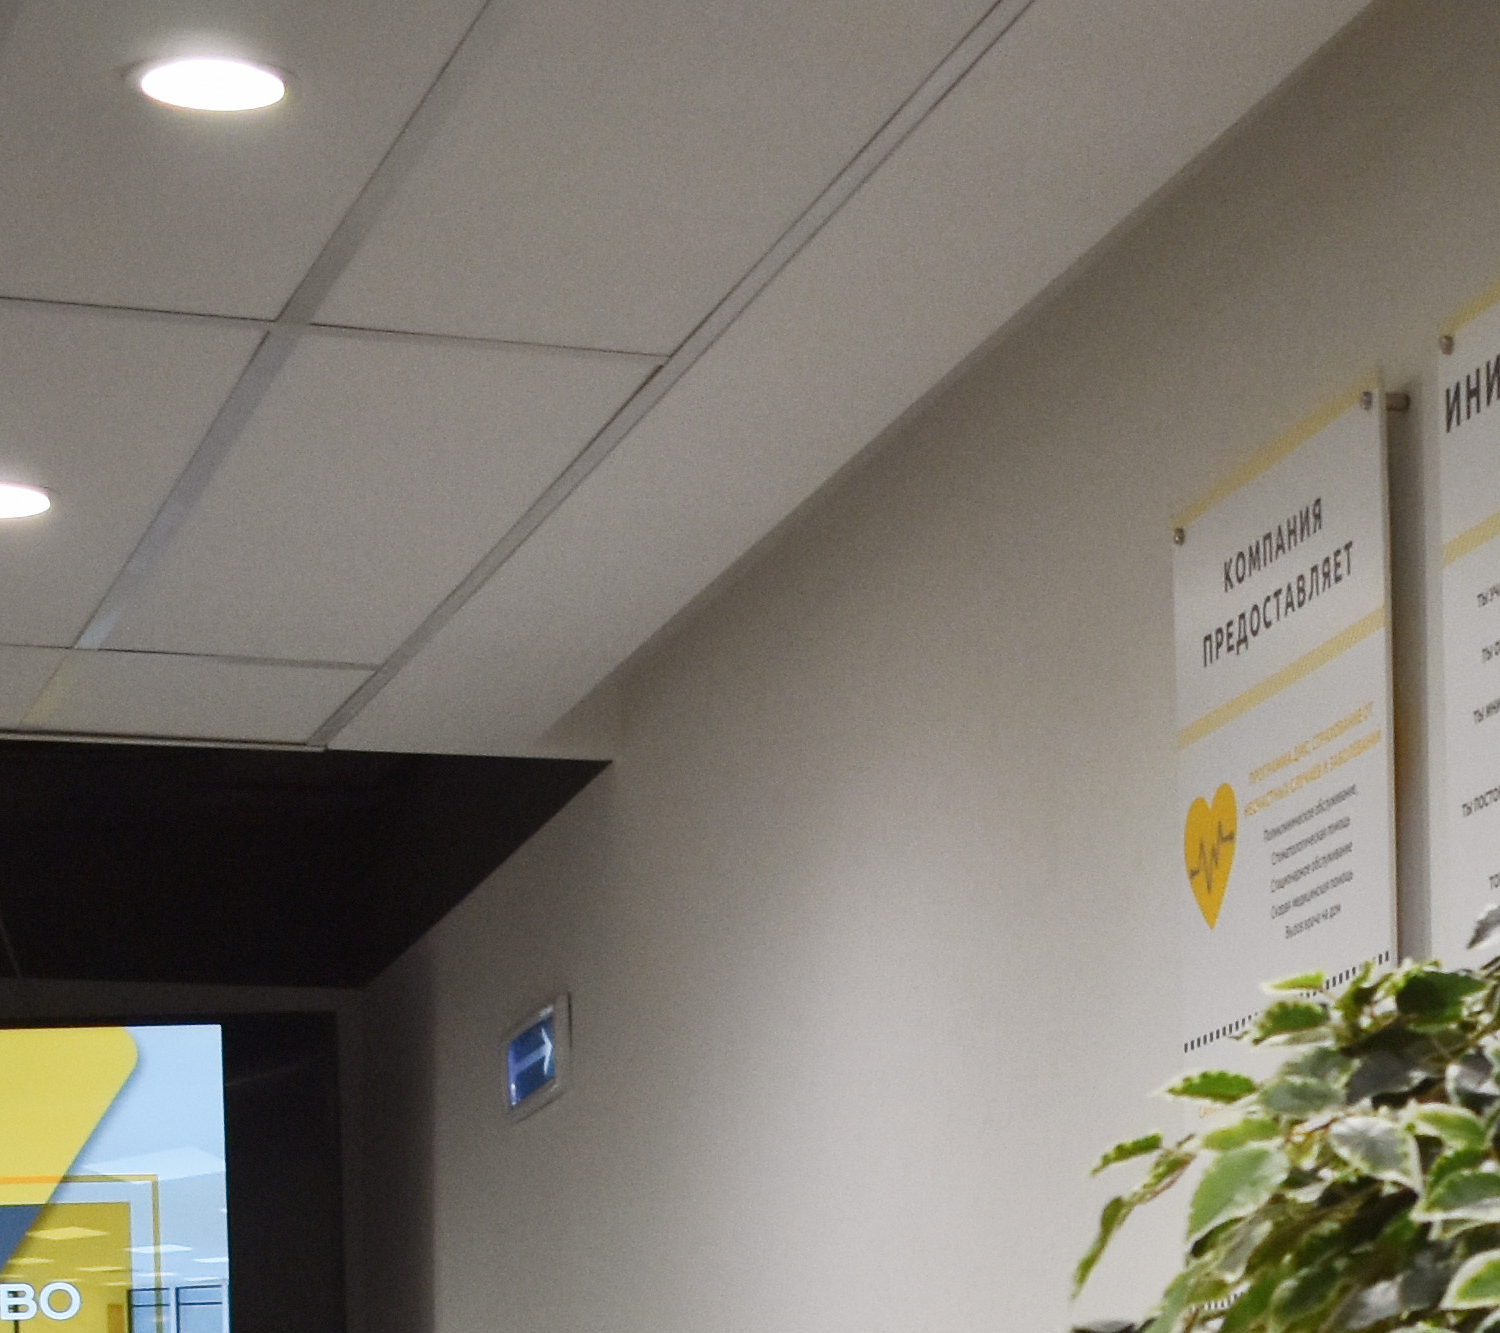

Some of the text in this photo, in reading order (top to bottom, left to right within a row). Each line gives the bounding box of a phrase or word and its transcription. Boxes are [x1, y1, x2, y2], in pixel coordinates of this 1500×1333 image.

[1223, 495, 1322, 593] КОМПАНИЯ
[1203, 540, 1352, 668] ПРЕДОСТАВЛЯЕТ
[1477, 589, 1487, 609] ТЫ
[1482, 643, 1492, 662] ТЫ
[1473, 706, 1484, 725] ТЫ
[1461, 800, 1471, 818] ТЫ
